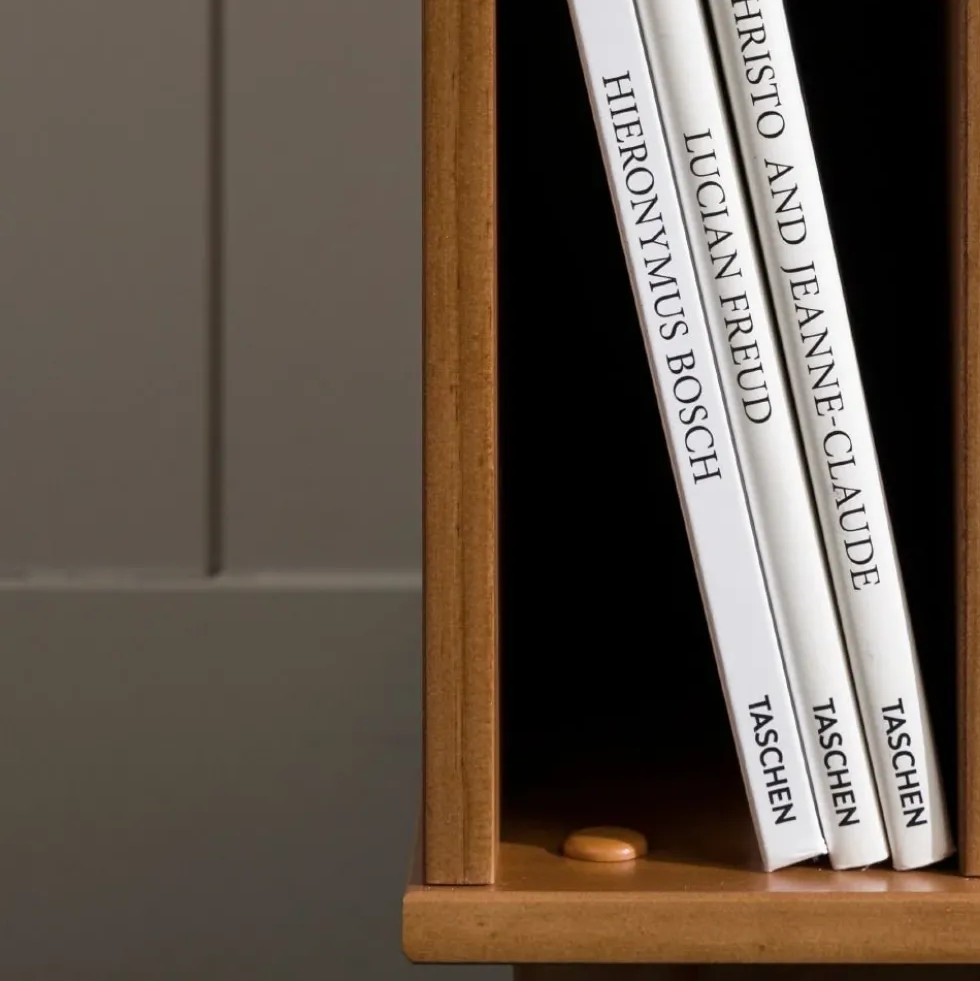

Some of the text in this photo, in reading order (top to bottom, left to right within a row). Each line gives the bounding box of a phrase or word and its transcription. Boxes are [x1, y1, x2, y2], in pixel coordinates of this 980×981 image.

[764, 158, 808, 246] AND
[602, 70, 722, 485] HIERONYMUS BOSCH
[683, 128, 773, 424] LUCIAN FREUD
[781, 260, 881, 591] JEANNE-CLAUDE
[748, 694, 796, 825] TASCHEN
[813, 697, 860, 828] TASCHEN
[882, 697, 928, 829] TASCHEN
